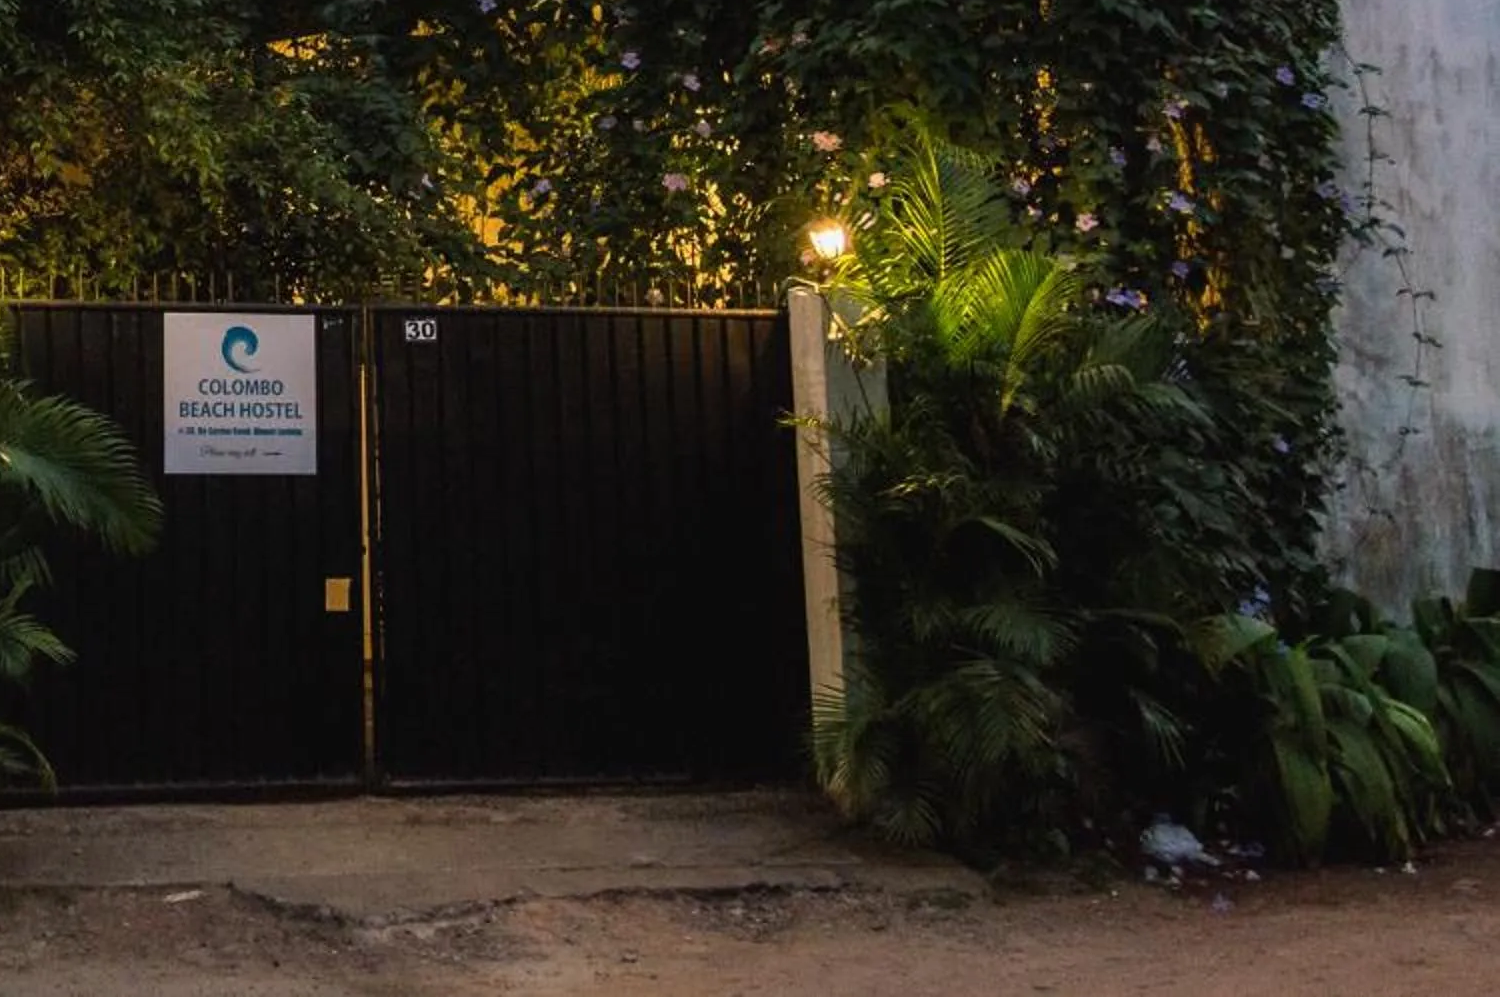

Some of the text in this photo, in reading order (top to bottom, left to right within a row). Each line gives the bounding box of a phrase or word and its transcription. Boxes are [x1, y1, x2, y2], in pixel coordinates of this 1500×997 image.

[407, 322, 435, 339] 30
[198, 379, 284, 396] COLOMBO
[179, 402, 303, 419] BEACH HOSTEL
